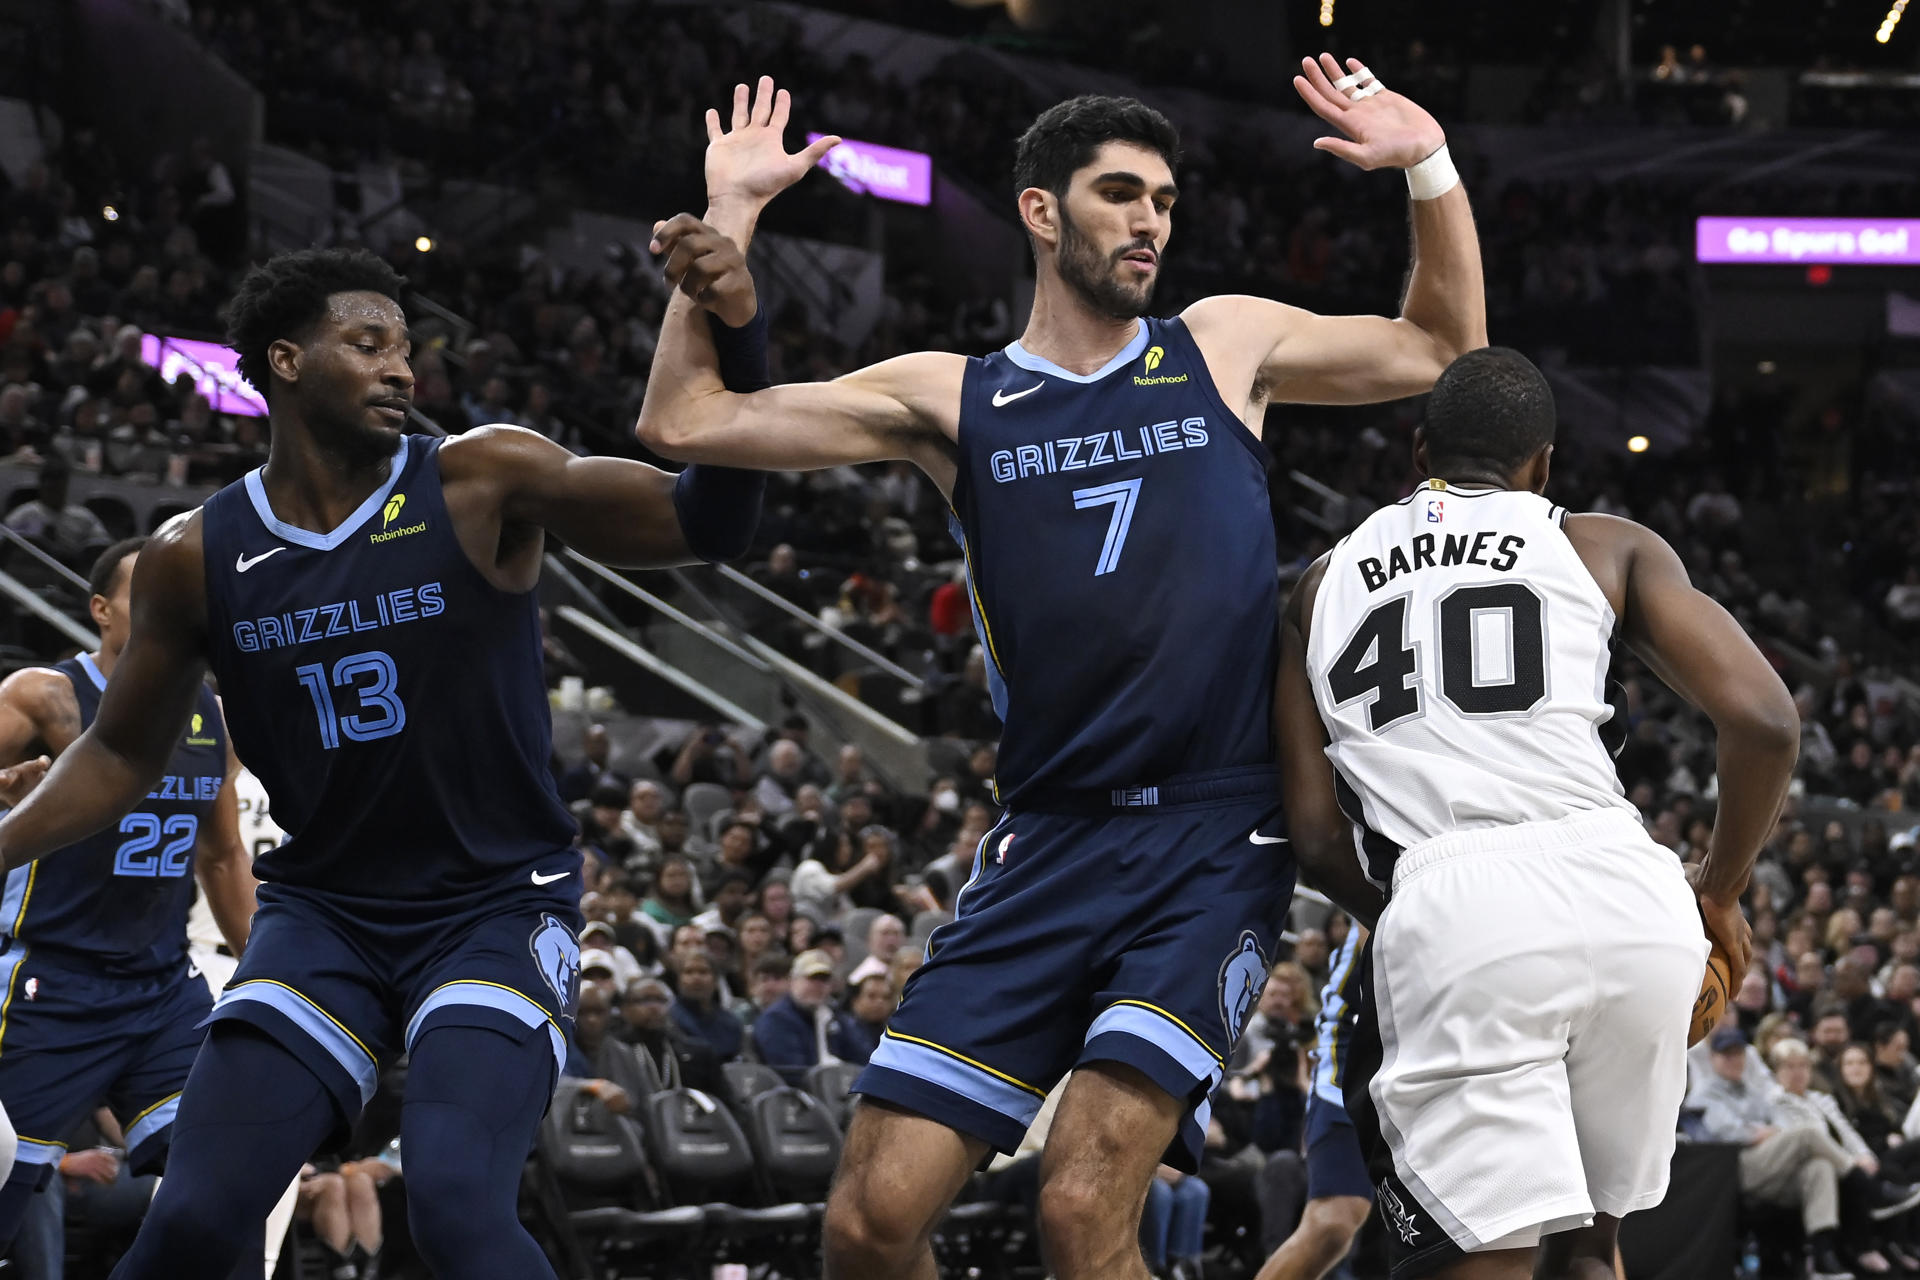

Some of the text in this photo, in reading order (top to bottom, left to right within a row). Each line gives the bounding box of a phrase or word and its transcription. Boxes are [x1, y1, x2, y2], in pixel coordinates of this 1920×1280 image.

[1133, 373, 1189, 386] Robinhood
[990, 416, 1209, 483] GRIZZLIES
[370, 521, 427, 544] Robinhood
[1072, 477, 1143, 577] 7
[1357, 531, 1526, 593] BARNES
[233, 582, 446, 653] GRIZZLIES
[1320, 578, 1553, 737] 40
[296, 650, 406, 750] 13
[113, 812, 199, 878] 22
